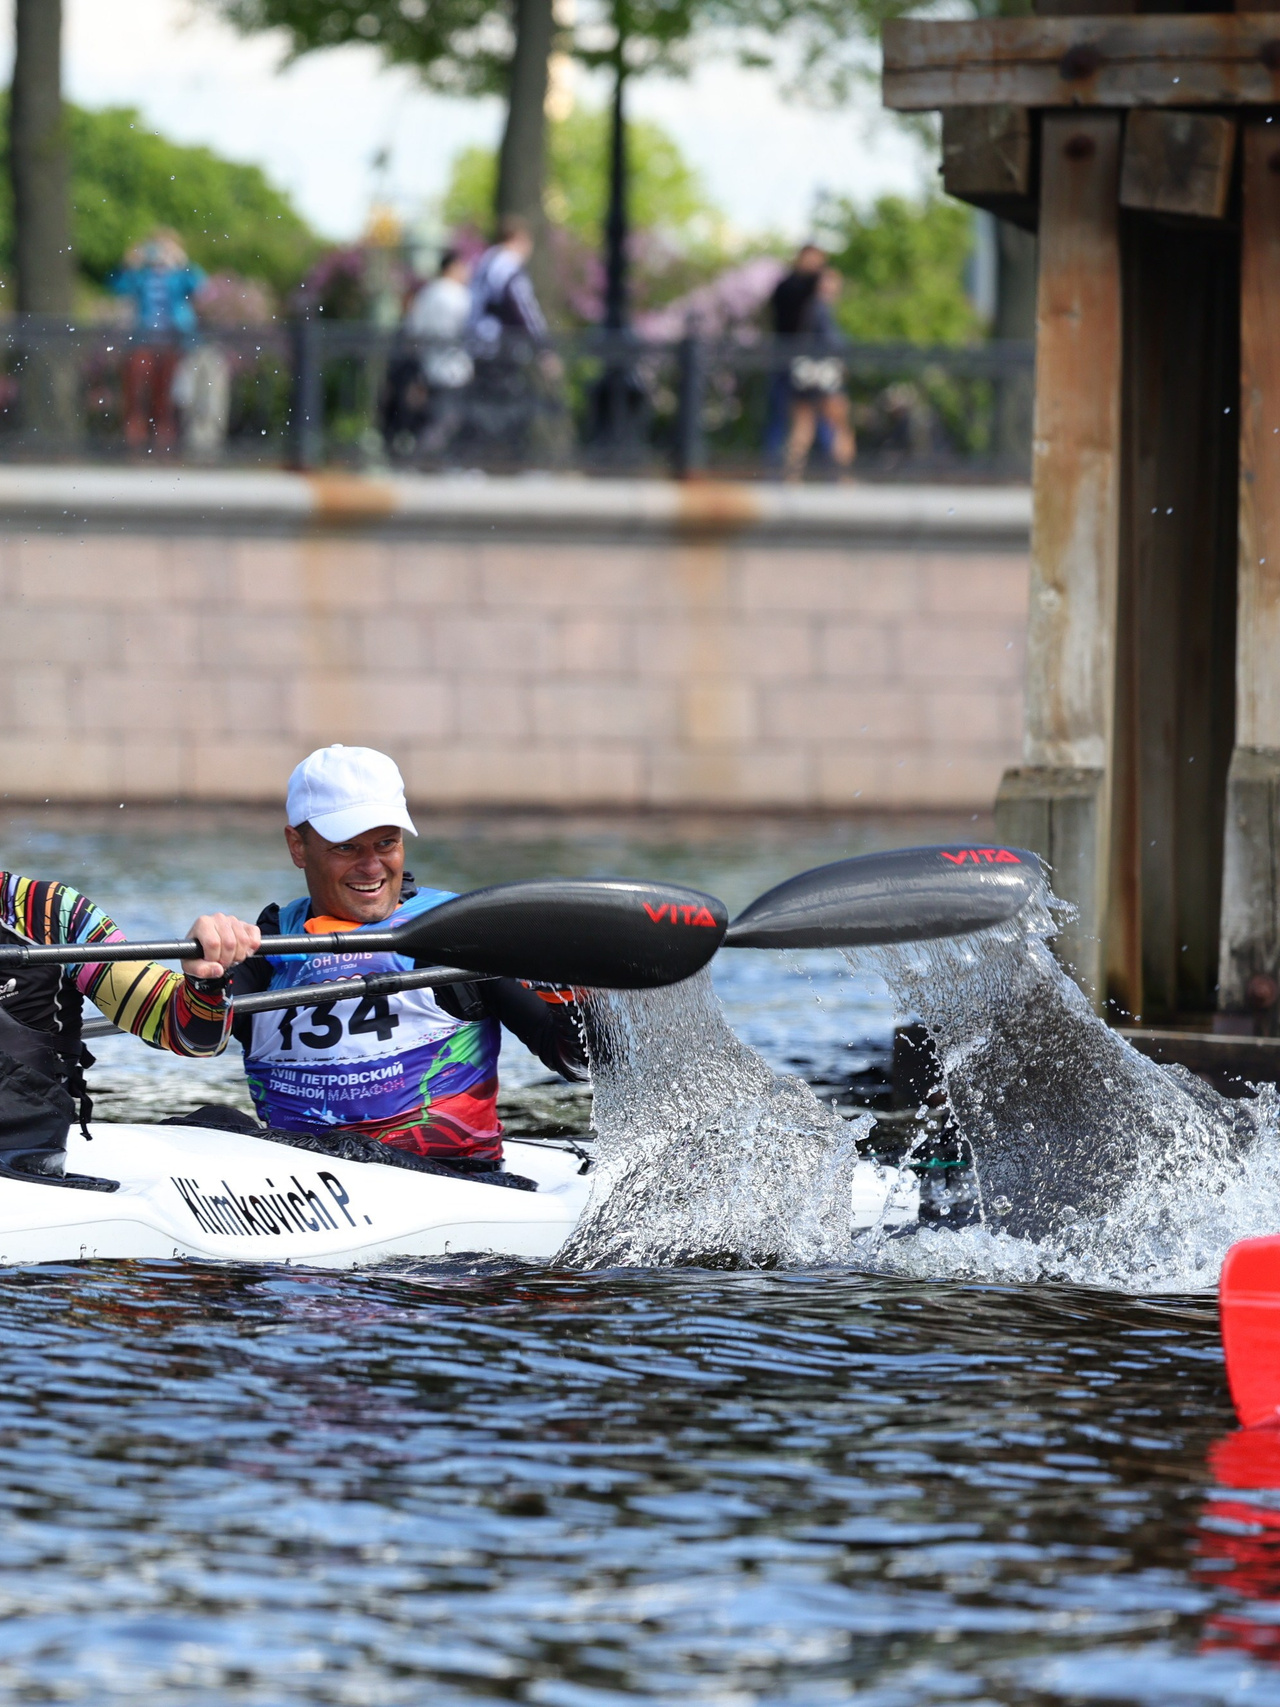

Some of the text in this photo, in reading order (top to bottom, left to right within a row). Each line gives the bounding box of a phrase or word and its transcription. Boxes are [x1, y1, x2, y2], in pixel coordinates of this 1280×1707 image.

[940, 848, 1022, 866] VITA
[642, 901, 718, 928] VITA
[301, 1060, 404, 1086] ПЕТРОВСКИЙ
[327, 1077, 406, 1101] МАРАФОН
[170, 1171, 373, 1236] Klimkovich P.
